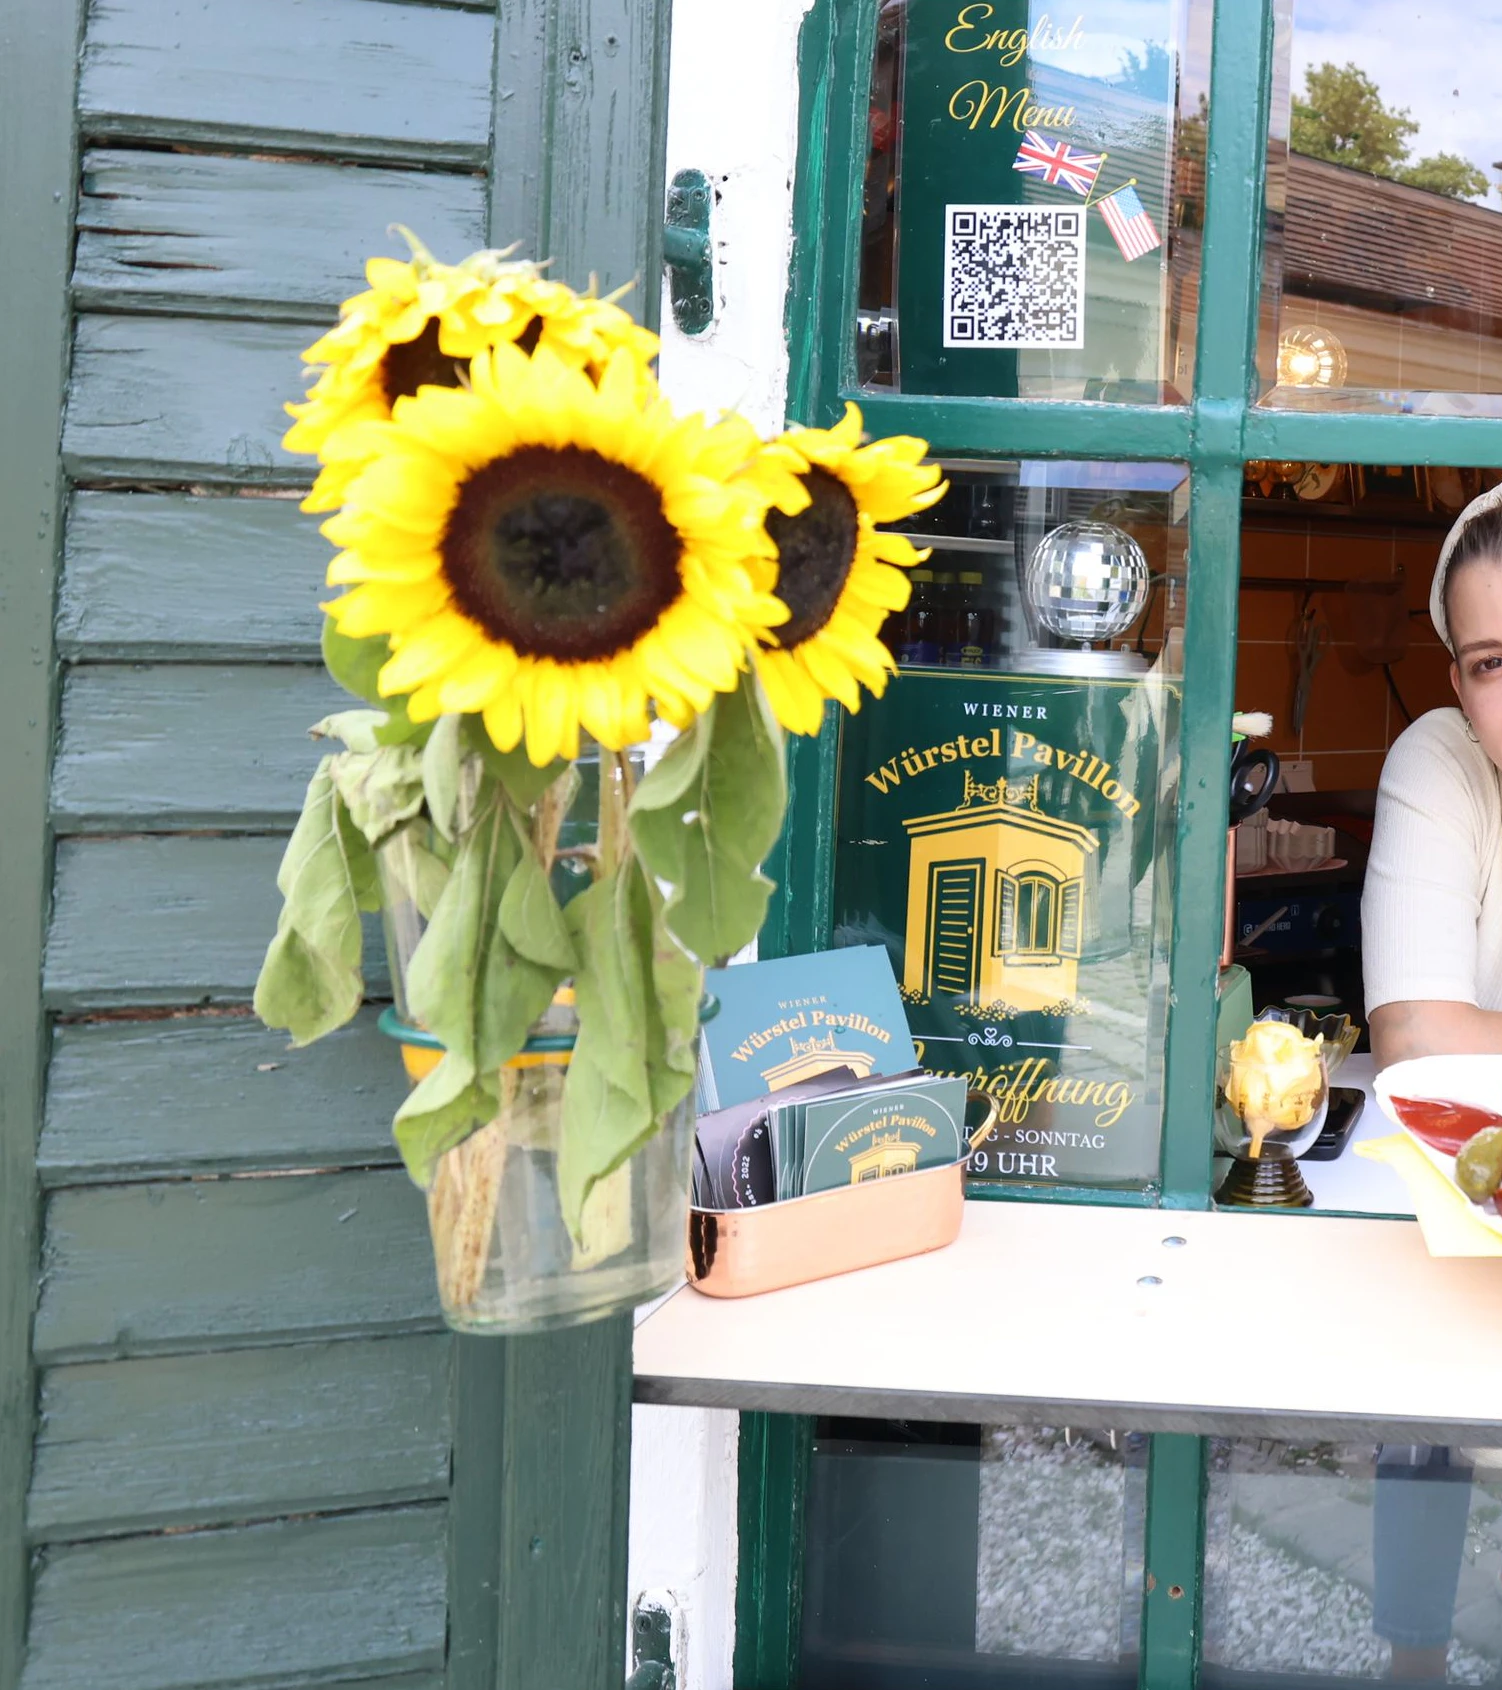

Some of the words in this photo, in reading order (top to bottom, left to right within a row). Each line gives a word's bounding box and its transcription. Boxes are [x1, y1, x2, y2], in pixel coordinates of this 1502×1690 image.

[944, 2, 1085, 67] English
[947, 80, 1077, 134] Menu
[963, 702, 1048, 720] WIENER
[864, 729, 1001, 796] Würstel
[1009, 730, 1142, 820] Pavillon
[778, 995, 827, 1010] WIENER
[731, 1011, 807, 1063] Würstel
[811, 1010, 892, 1044] Pavillon
[872, 1104, 905, 1115] WIENER
[834, 1115, 887, 1153] Würstel
[890, 1114, 937, 1137] Pavillon
[1015, 1129, 1106, 1149] SONNTAG
[741, 1155, 750, 1179] 2022
[997, 1152, 1059, 1177] UHR
